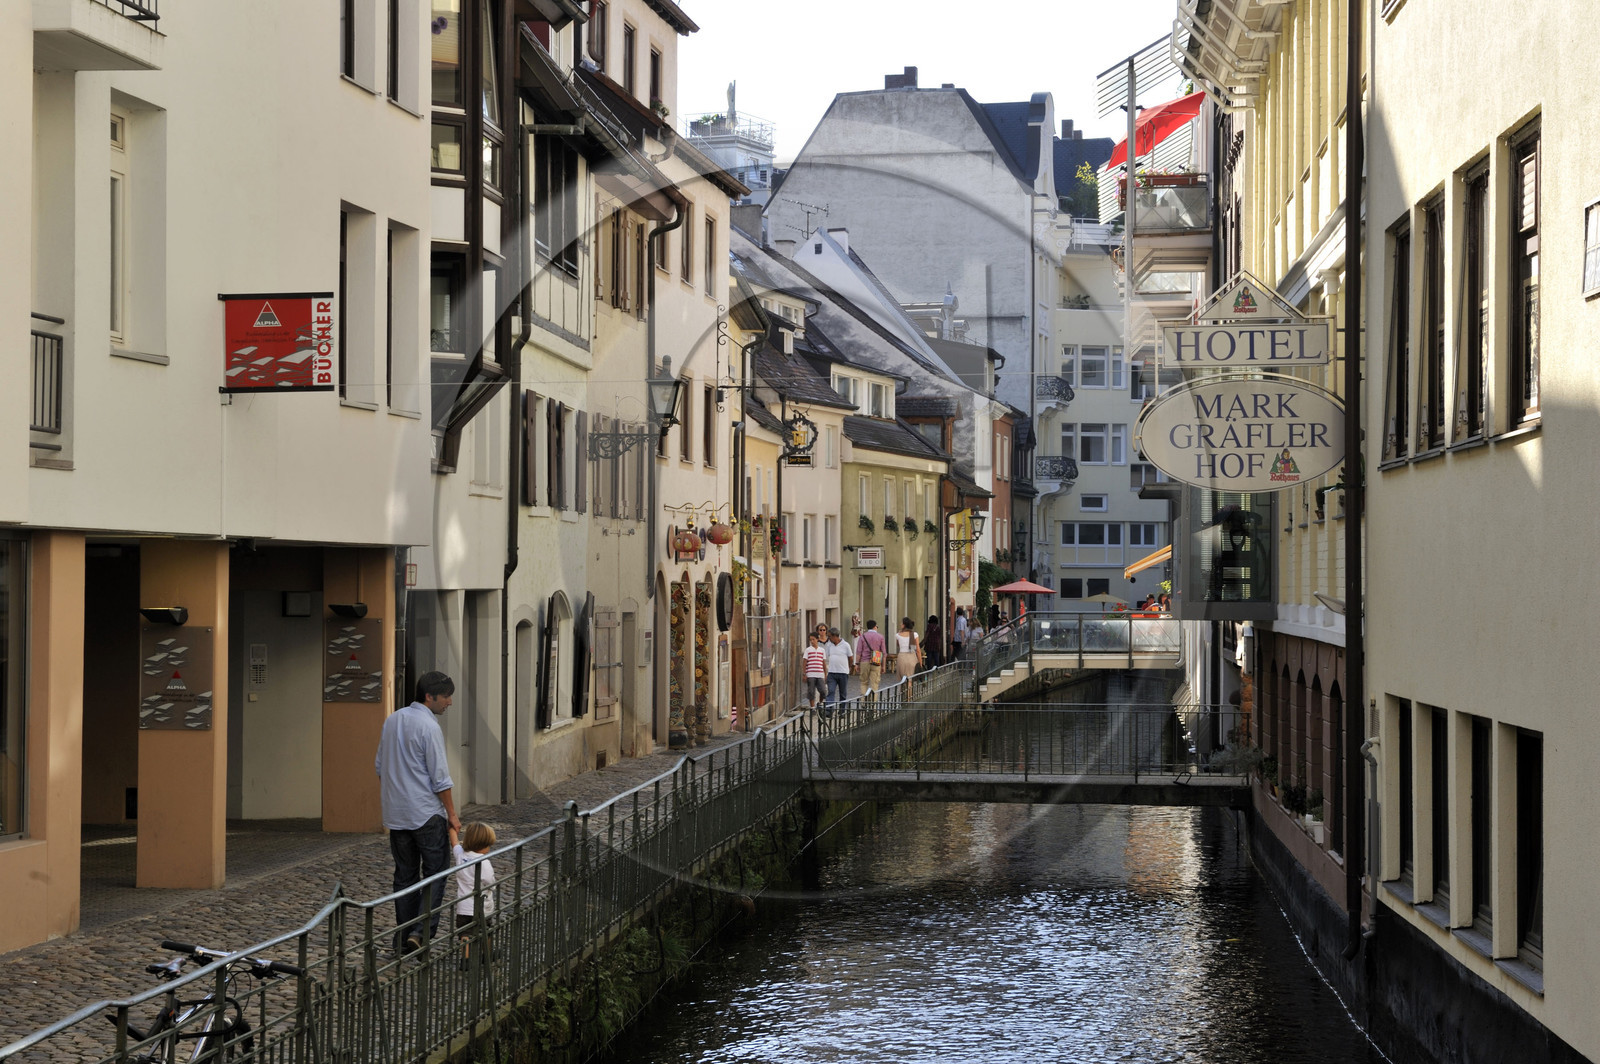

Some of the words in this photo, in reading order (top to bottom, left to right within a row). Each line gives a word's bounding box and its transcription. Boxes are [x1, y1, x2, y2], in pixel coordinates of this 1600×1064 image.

[1233, 305, 1257, 314] Rothaus
[314, 301, 332, 384] BÜCHER
[1173, 329, 1322, 362] HOTEL
[1194, 393, 1300, 419] MARK
[1169, 417, 1332, 449] GRÄFLER
[1194, 453, 1265, 479] HOF
[1269, 472, 1300, 483] Rothaus
